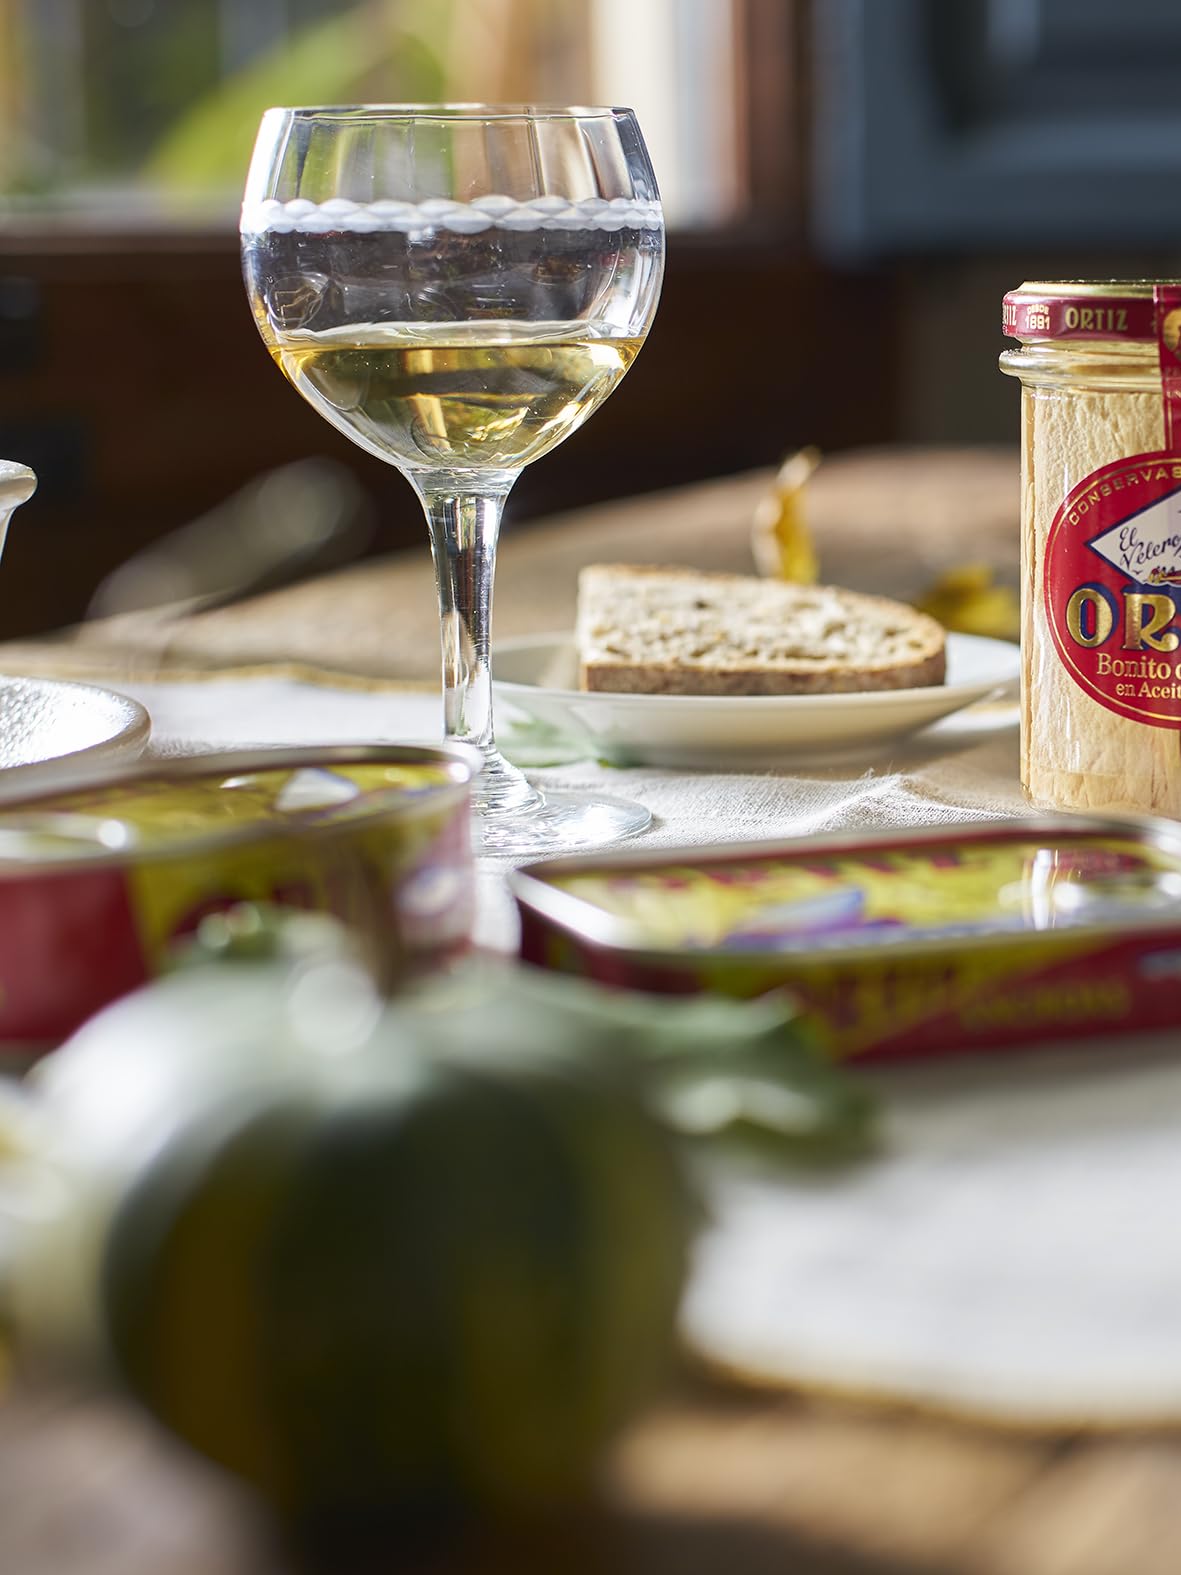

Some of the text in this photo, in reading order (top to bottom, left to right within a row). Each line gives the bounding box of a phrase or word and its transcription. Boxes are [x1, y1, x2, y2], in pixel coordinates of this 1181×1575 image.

[1024, 314, 1051, 330] 1891
[1065, 307, 1128, 331] ORTIZ
[1118, 525, 1138, 550] El
[1096, 652, 1172, 678] Bonito
[1116, 684, 1136, 697] en
